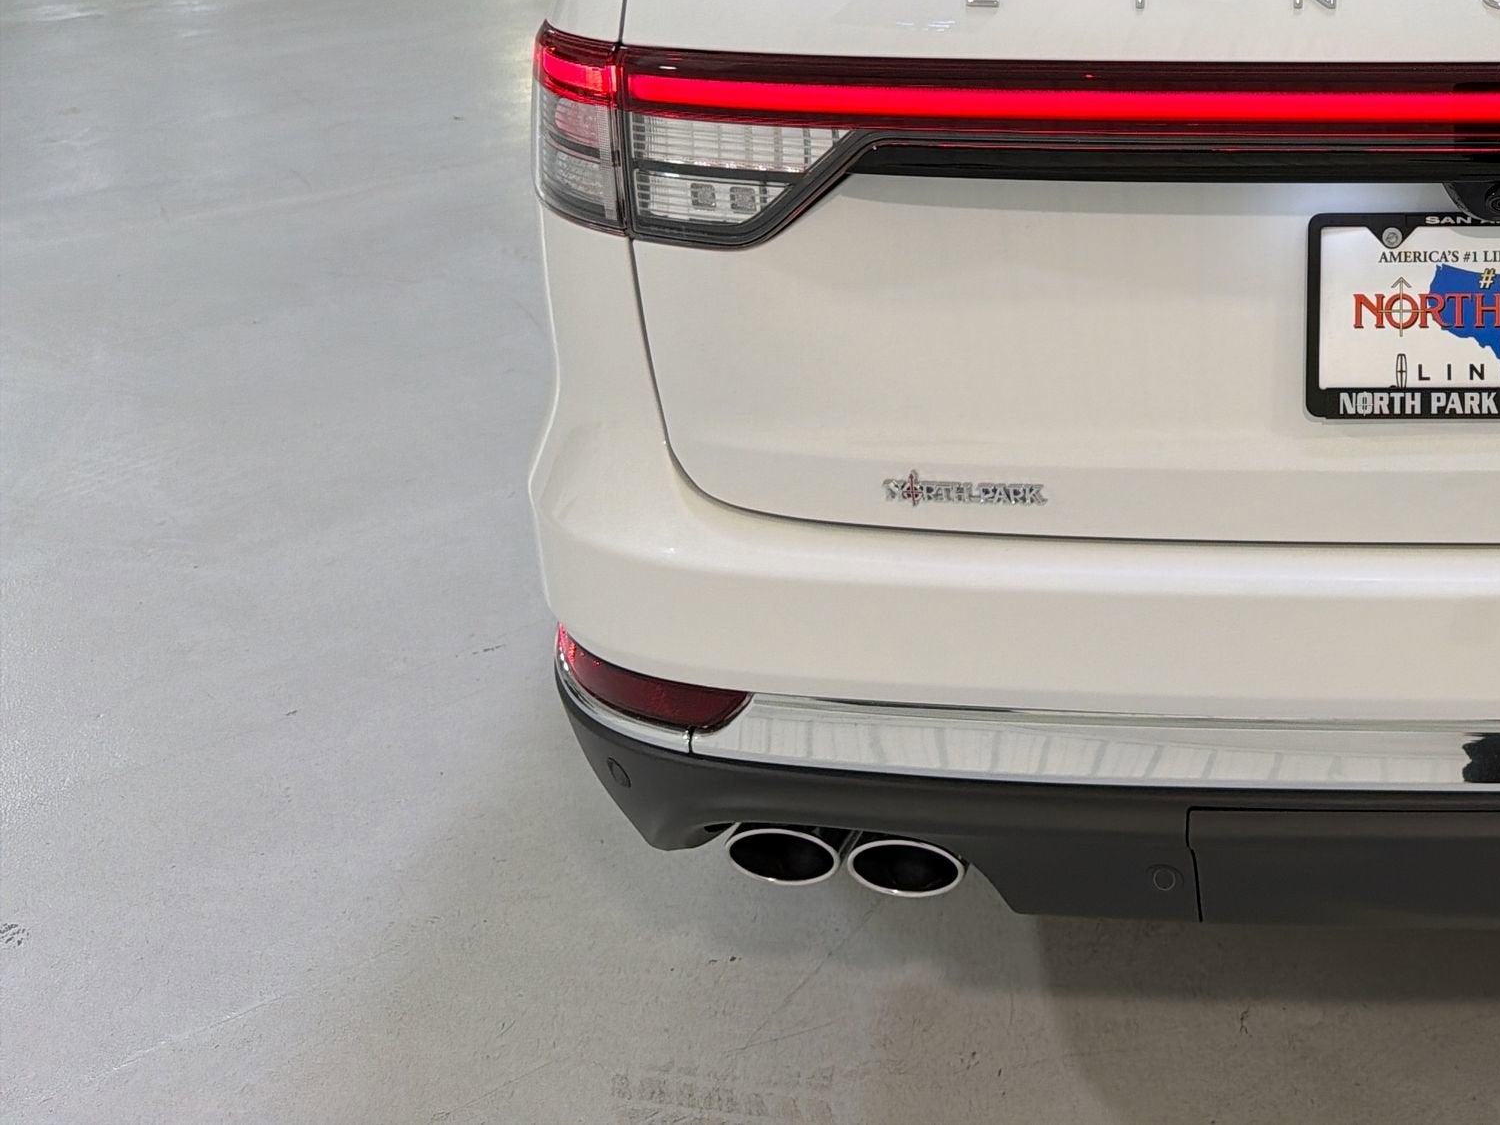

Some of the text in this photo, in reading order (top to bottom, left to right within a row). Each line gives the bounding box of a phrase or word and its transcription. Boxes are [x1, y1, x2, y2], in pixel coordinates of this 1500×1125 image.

[1425, 215, 1471, 224] SAN
[1378, 250, 1459, 264] AMERICA'S
[1463, 251, 1479, 263] #1
[1339, 391, 1422, 416] NORTH
[1430, 391, 1499, 415] PARK
[978, 483, 1047, 506] PARK
